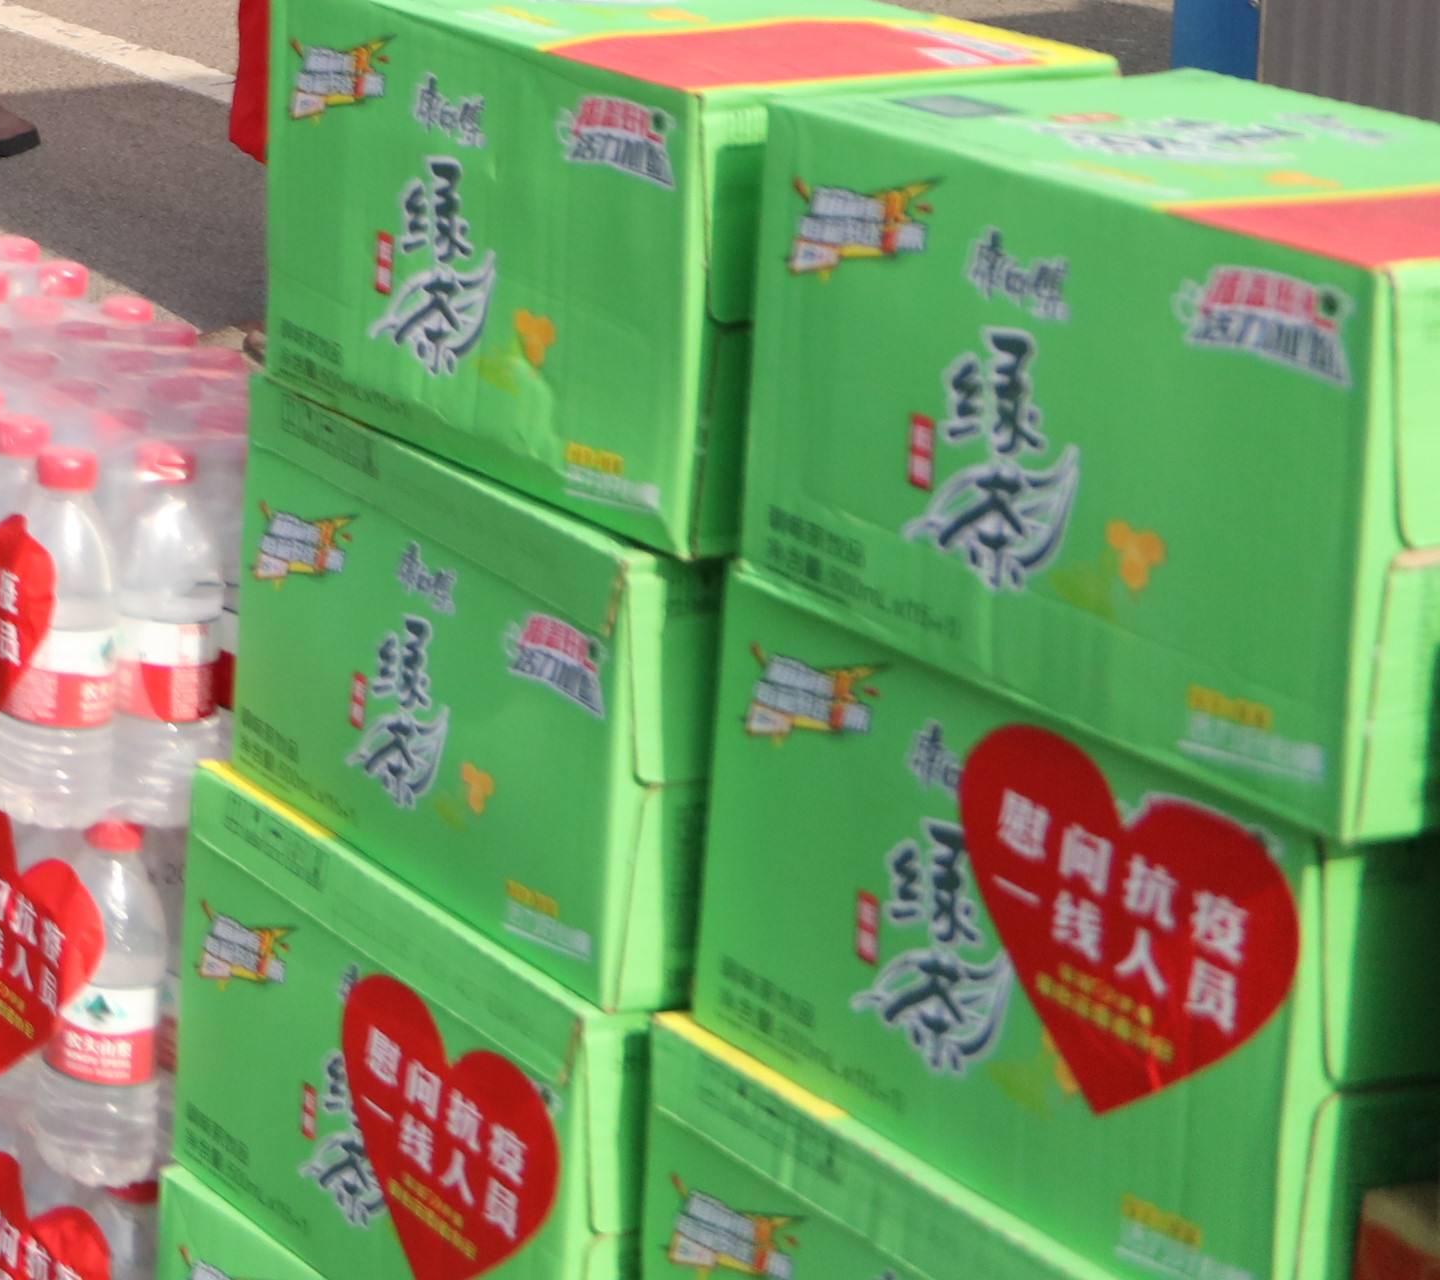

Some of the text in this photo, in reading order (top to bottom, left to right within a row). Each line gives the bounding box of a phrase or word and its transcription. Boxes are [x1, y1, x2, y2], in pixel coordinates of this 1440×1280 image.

[991, 873, 1238, 1034] 一线人员
[996, 788, 1249, 967] 慰问抗疫
[360, 1094, 520, 1242] 一线人员
[364, 1024, 529, 1186] 慰问抗疫
